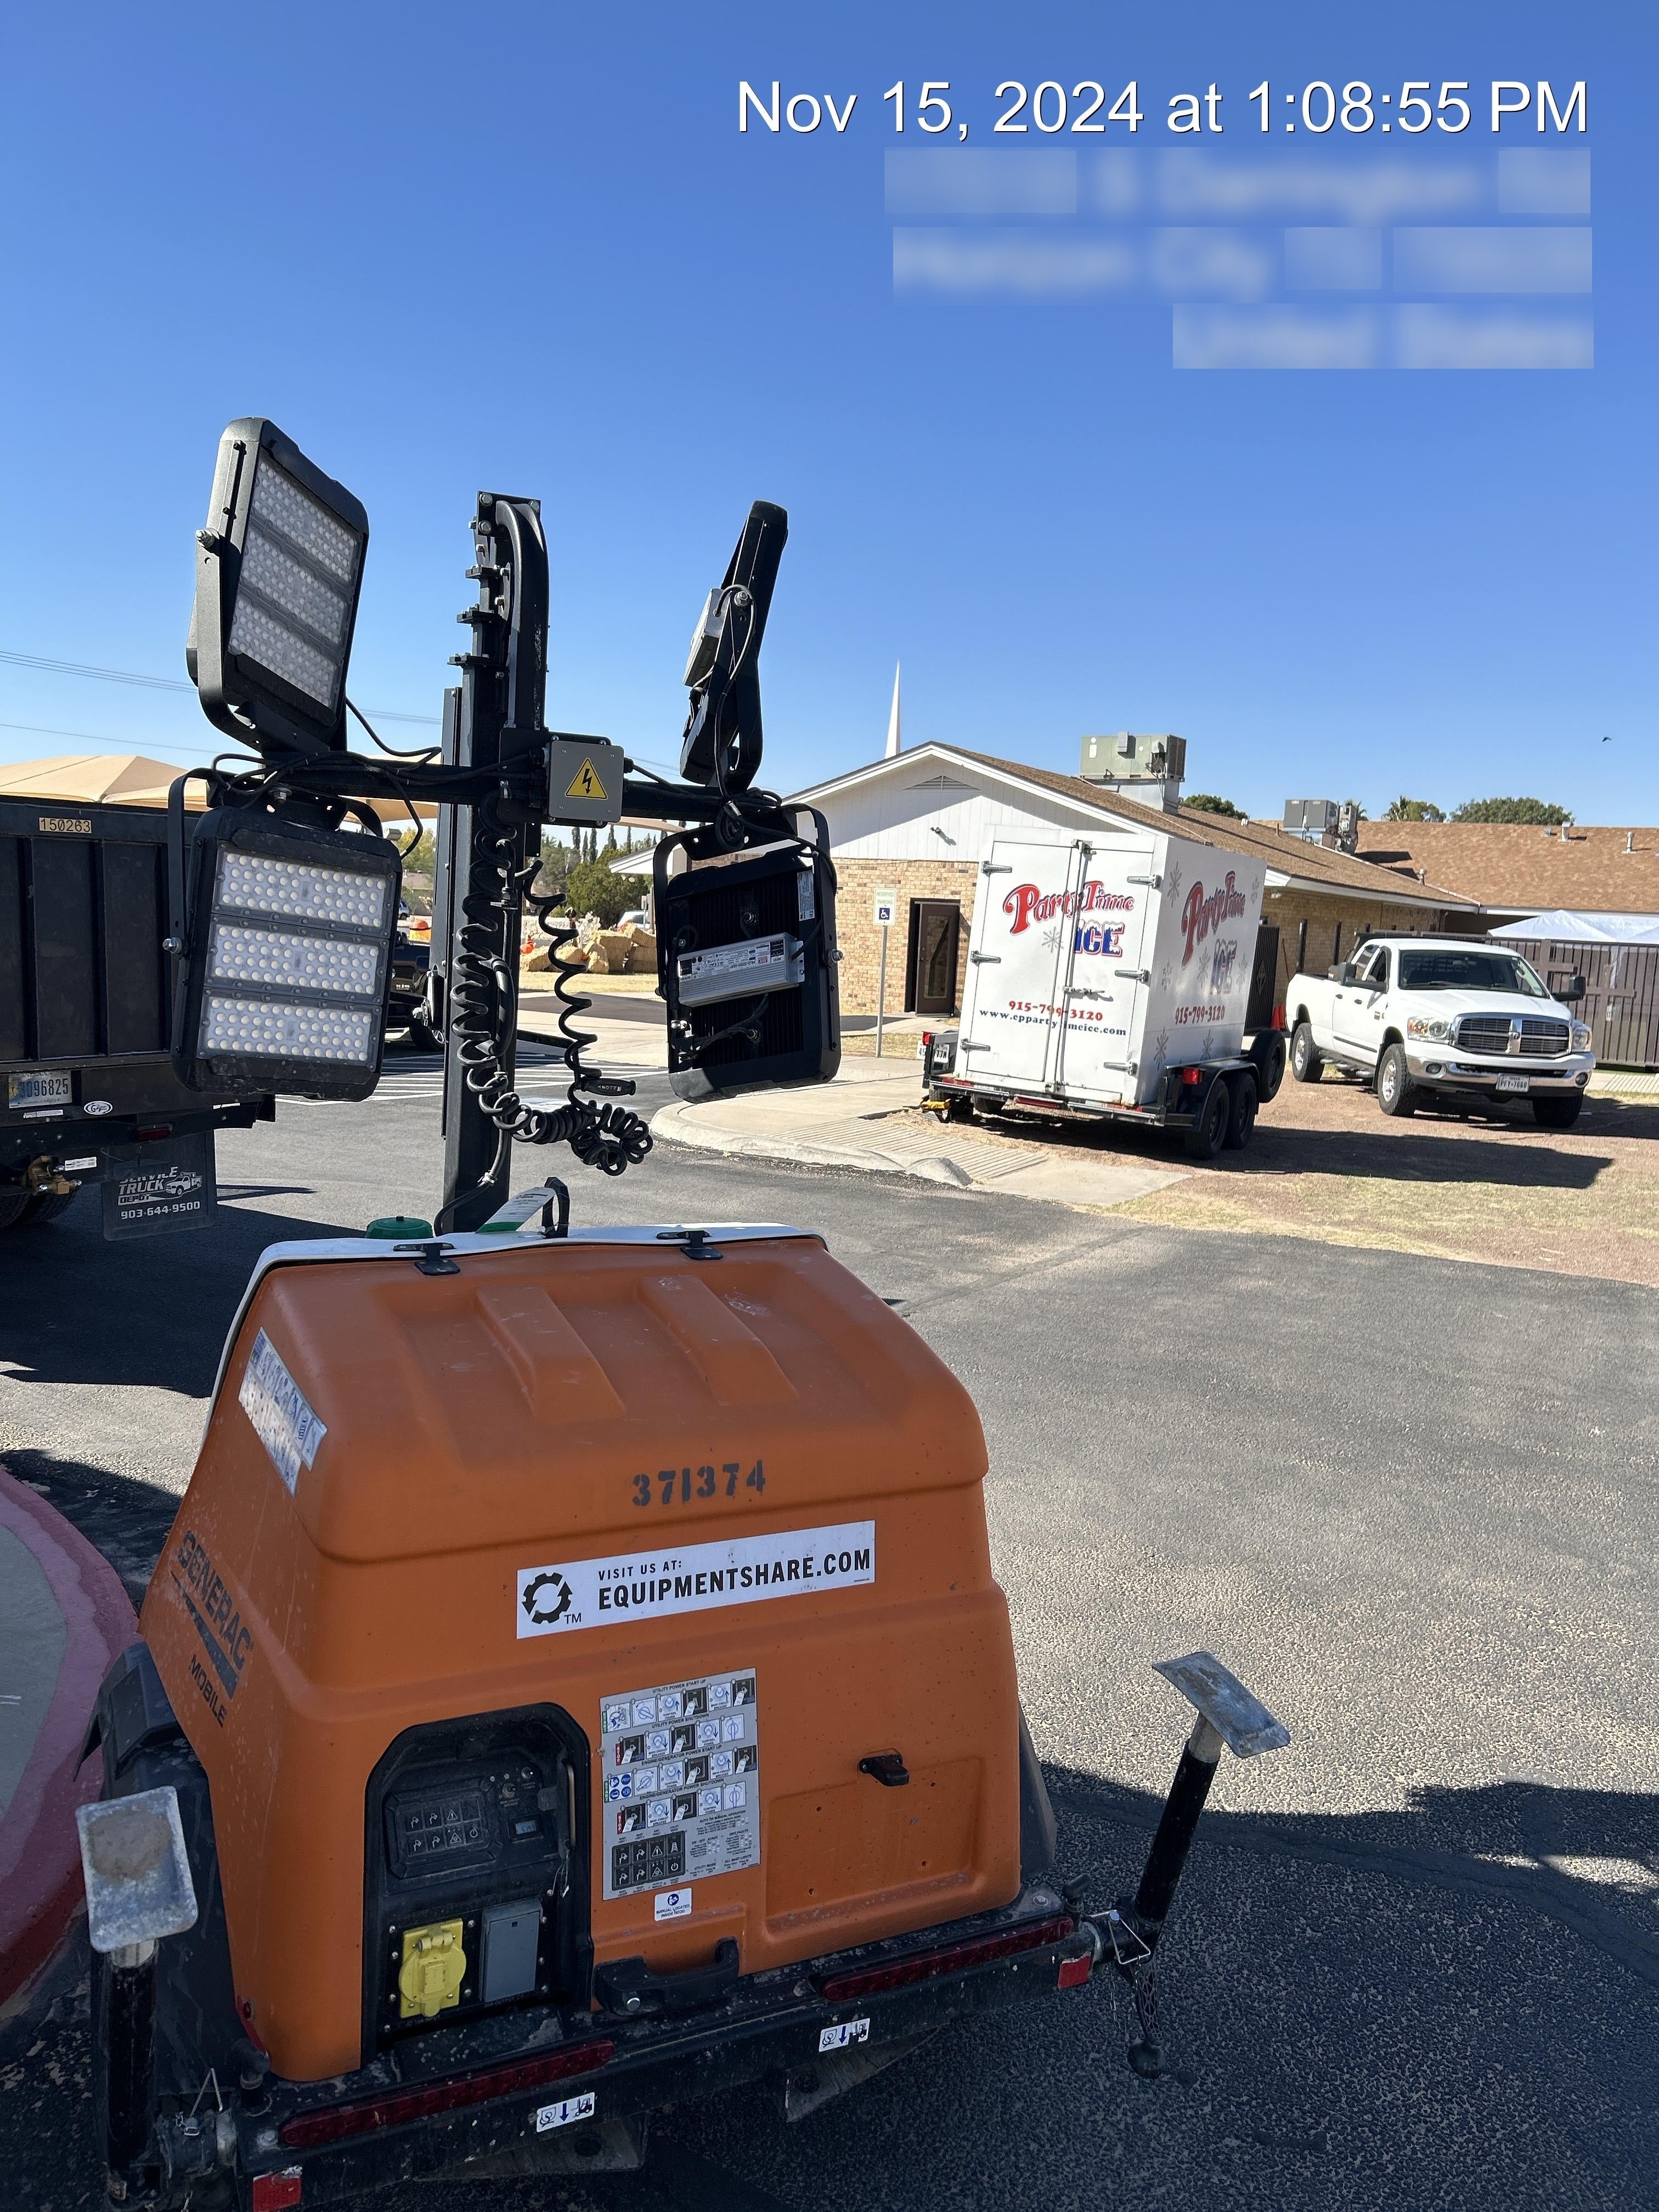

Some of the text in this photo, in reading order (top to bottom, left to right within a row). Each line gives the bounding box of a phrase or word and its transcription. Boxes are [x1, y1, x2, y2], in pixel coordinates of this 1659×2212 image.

[41, 818, 91, 833] 150263
[1009, 1000, 1103, 1022] 915-799-3120
[1175, 1005, 1225, 1025] 915-799-3120
[119, 1180, 165, 1195] TRUCK
[632, 1459, 766, 1507] 371374
[599, 1560, 682, 1581] VISIT US AT:
[599, 1548, 870, 1610] EQUIPMENTSHARE.COM
[177, 1531, 252, 1671] GENERAC
[564, 1612, 582, 1624] TM
[189, 1654, 228, 1729] MOBILE
